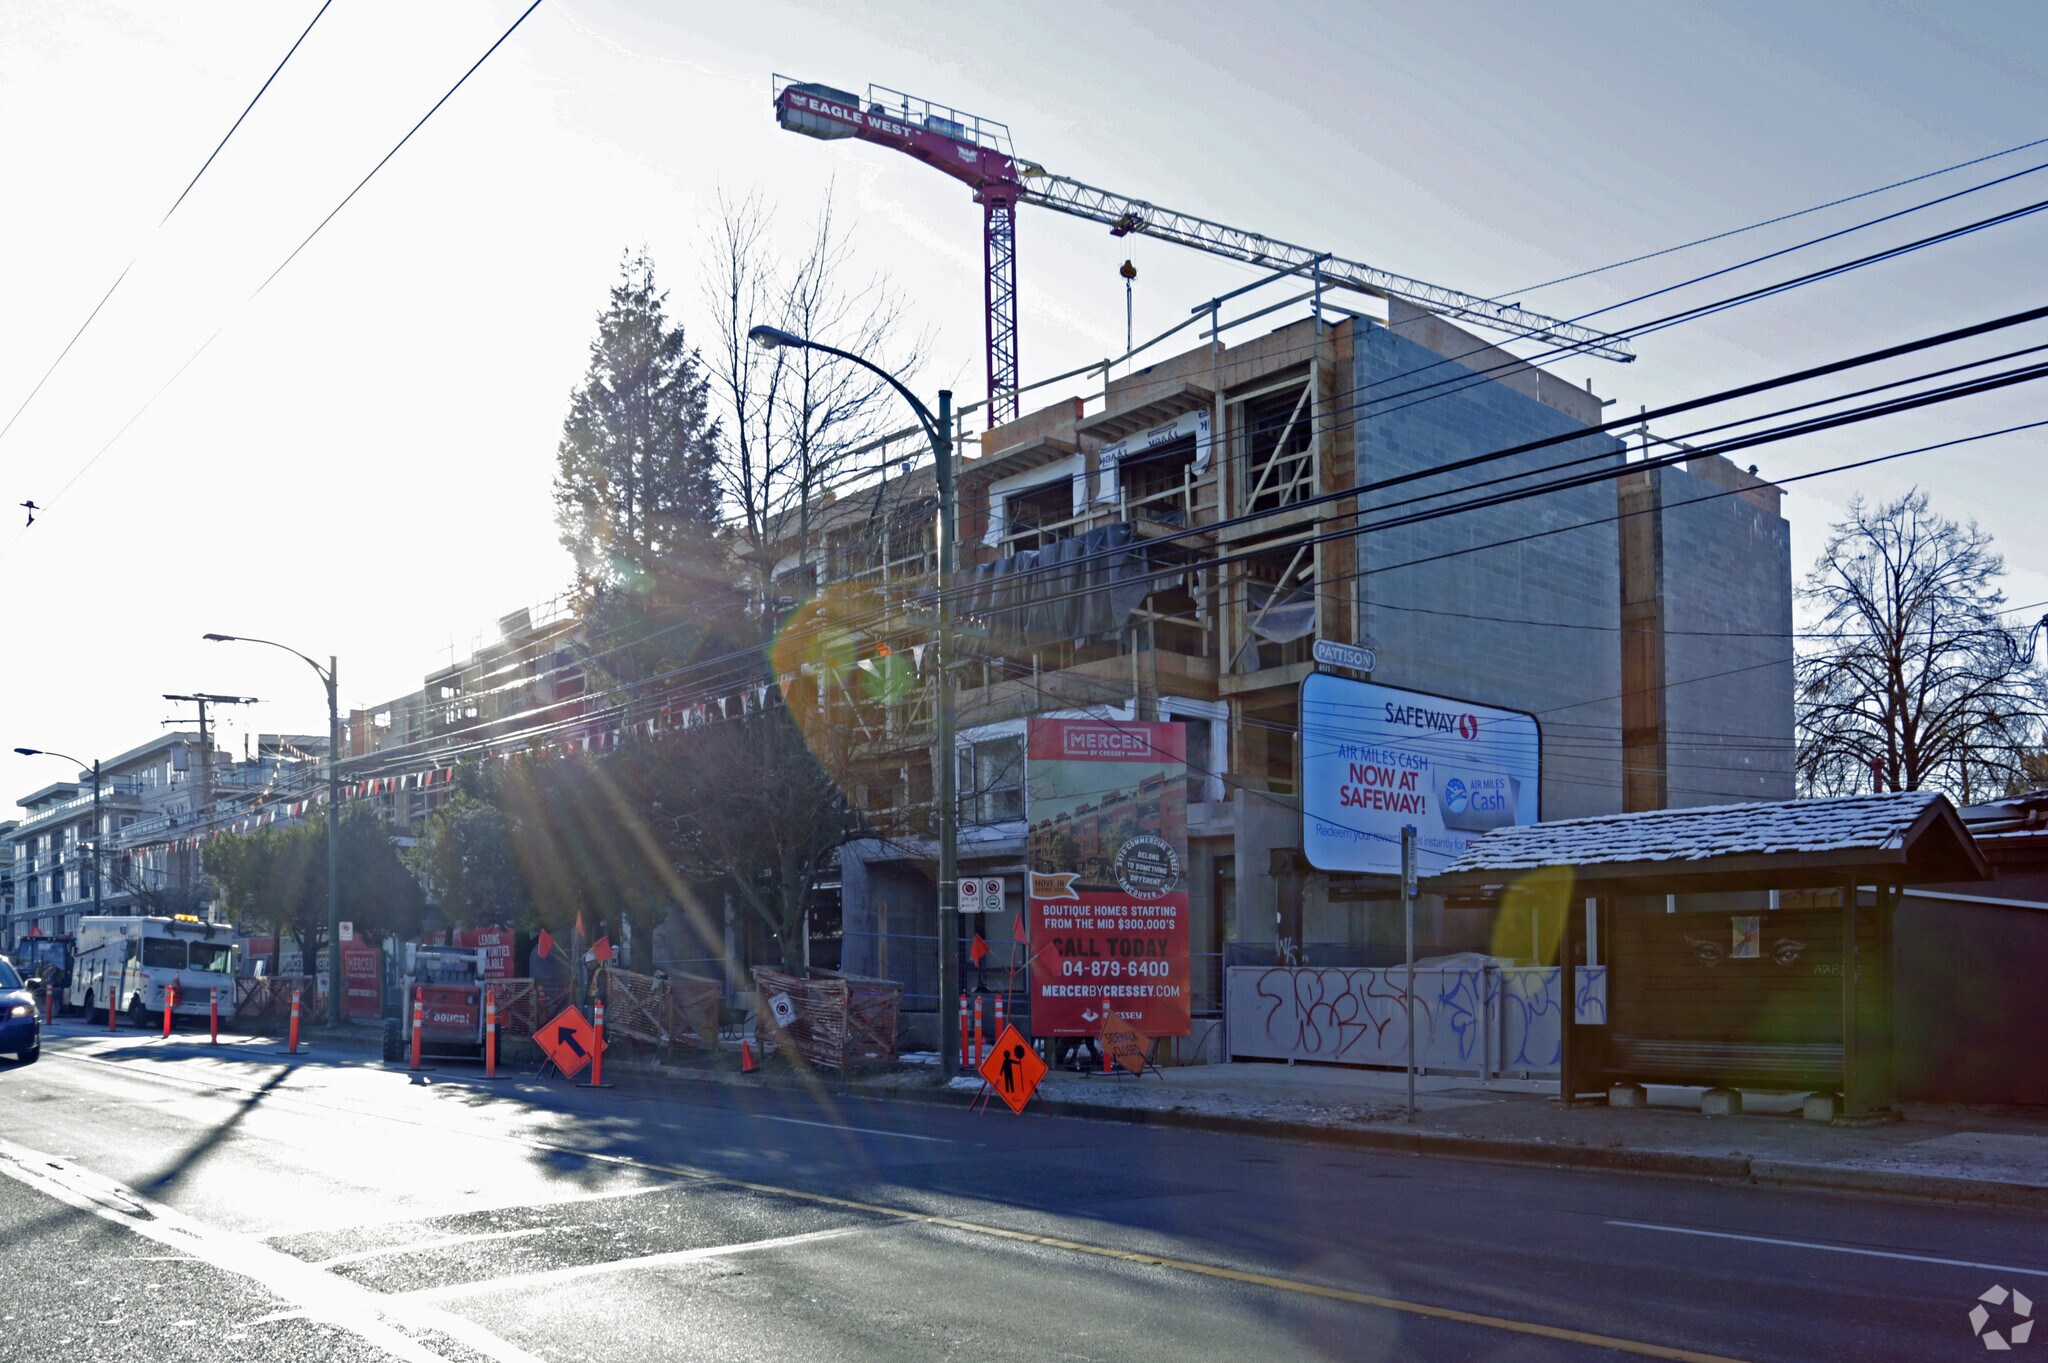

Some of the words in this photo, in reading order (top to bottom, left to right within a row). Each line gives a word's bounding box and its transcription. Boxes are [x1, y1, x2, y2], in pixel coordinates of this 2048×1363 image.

[809, 98, 863, 124] EAGLE
[867, 115, 911, 137] WEST
[1318, 644, 1371, 667] PATTISON
[1385, 702, 1457, 734] SAFEWAY
[1070, 732, 1144, 749] MERCER
[1338, 743, 1358, 761] AIR
[1360, 747, 1396, 767] MILES
[1398, 753, 1428, 771] CASH
[1349, 762, 1396, 788] NOW
[1399, 770, 1419, 792] AT
[1470, 779, 1482, 790] AIR
[1483, 778, 1505, 789] MILES
[1340, 784, 1426, 815] SAFEWAY!
[1471, 789, 1505, 812] Cash
[1315, 823, 1352, 839] Redeem
[1424, 837, 1453, 852] instantly
[1454, 838, 1464, 850] for
[1126, 836, 1167, 851] COMMERCIAL
[1166, 849, 1178, 876] STREET
[1137, 851, 1160, 861] BELONG
[1127, 861, 1135, 869] TO
[1135, 863, 1168, 875] SOMETHING
[1035, 879, 1055, 888] MOVE
[1057, 879, 1065, 888] IN
[1130, 874, 1161, 886] DIFFERENT
[1043, 905, 1091, 918] BOUTIQUE
[1094, 905, 1128, 917] HOMES
[1131, 905, 1177, 917] STARTING
[1044, 918, 1072, 929] FROM
[1075, 918, 1094, 929] THE
[1097, 918, 1115, 929] MID
[1118, 918, 1175, 931] $300,000'S
[478, 933, 500, 946] LEASING
[1106, 937, 1168, 957] TODAY
[347, 957, 375, 971] MERCER
[1042, 985, 1180, 998] MERCERBYCRESSEY.COM
[1104, 1030, 1138, 1044] SIDEWALK
[1114, 1044, 1140, 1058] CLOSED
